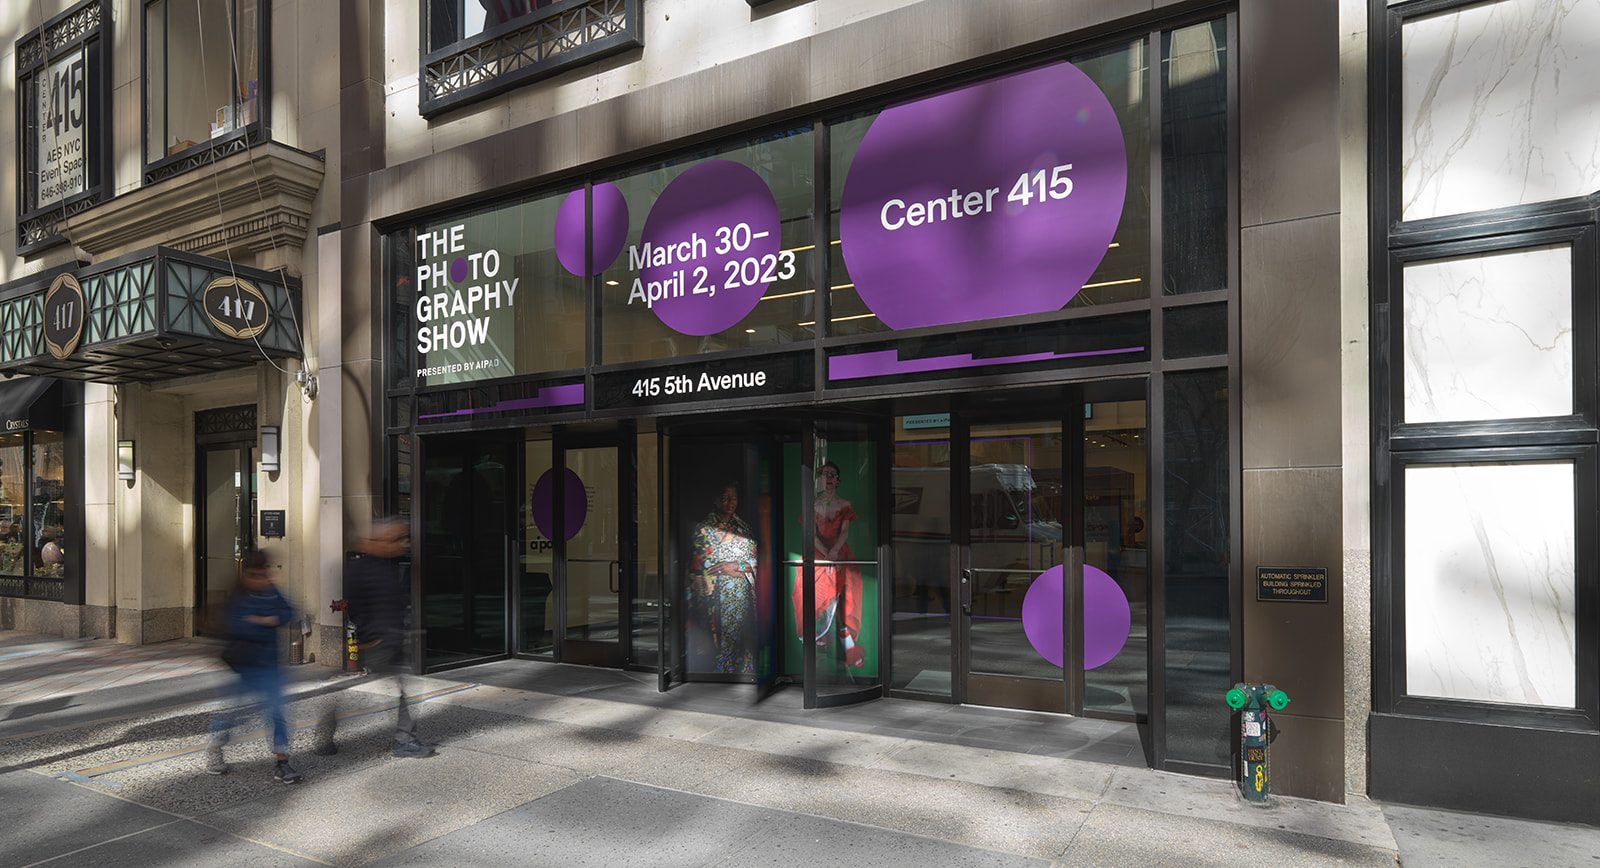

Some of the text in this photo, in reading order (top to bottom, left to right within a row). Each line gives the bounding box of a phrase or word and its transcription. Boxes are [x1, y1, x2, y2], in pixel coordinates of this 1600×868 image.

[47, 60, 83, 137] 415
[46, 138, 81, 164] AES NYC
[63, 158, 83, 175] Spac
[880, 163, 1073, 231] Center 415
[416, 224, 465, 260] THE
[628, 232, 707, 271] March
[627, 251, 796, 309] April 2, 2023
[53, 301, 74, 331] 417
[217, 295, 255, 321] 417
[416, 277, 520, 323] GRAPHY
[417, 316, 490, 354] SHOW
[417, 358, 500, 378] PRESENTED BY AIPAD
[632, 371, 766, 397] 415 5th Avenue
[1272, 588, 1312, 596] THROUGHOUT
